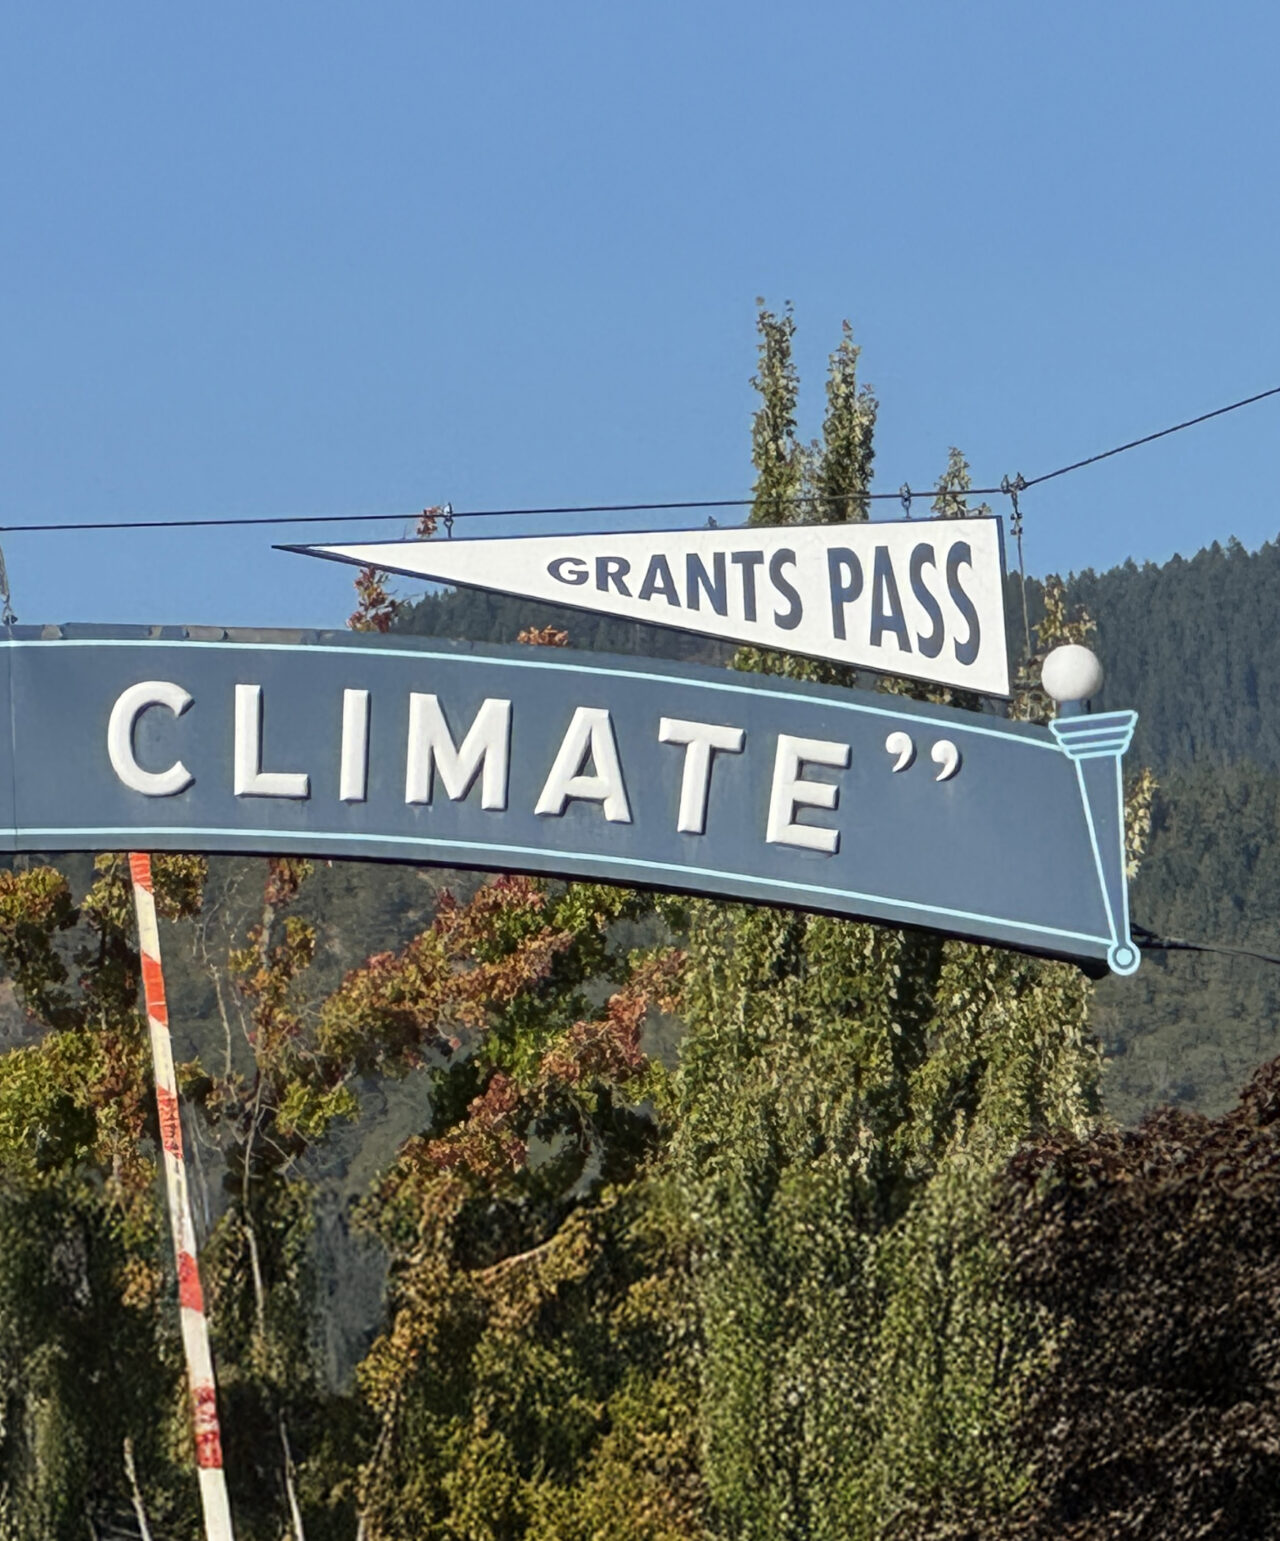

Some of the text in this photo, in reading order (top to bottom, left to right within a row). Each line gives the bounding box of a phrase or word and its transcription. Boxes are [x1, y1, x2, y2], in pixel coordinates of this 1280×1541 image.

[547, 541, 983, 666] GRANTS PASS
[107, 681, 963, 854] CLIMATE”
